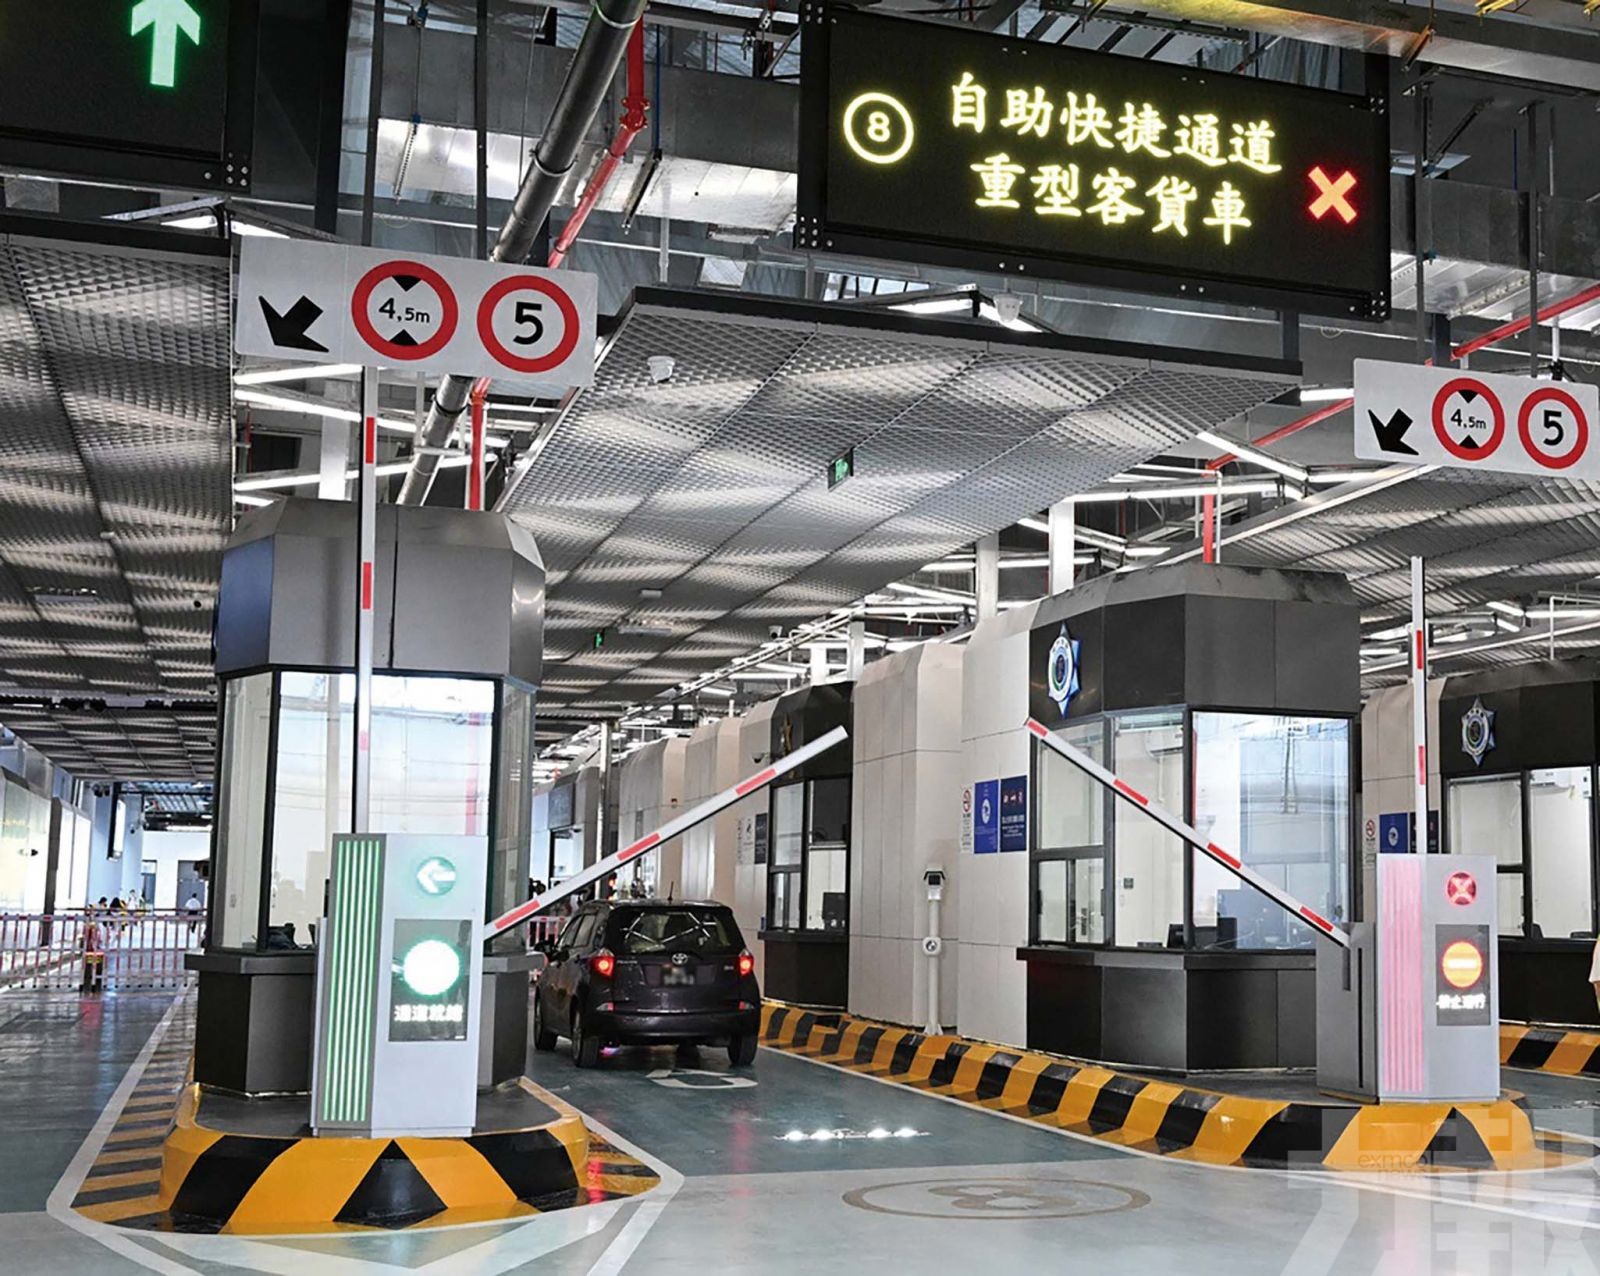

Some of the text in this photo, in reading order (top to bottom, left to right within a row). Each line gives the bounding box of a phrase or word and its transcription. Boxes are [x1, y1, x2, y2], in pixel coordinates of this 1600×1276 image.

[866, 110, 891, 142] 8
[951, 71, 1283, 175] 自助快捷通道
[970, 152, 1253, 245] 重型客貨車
[512, 301, 544, 346] 5
[1544, 409, 1564, 446] 5
